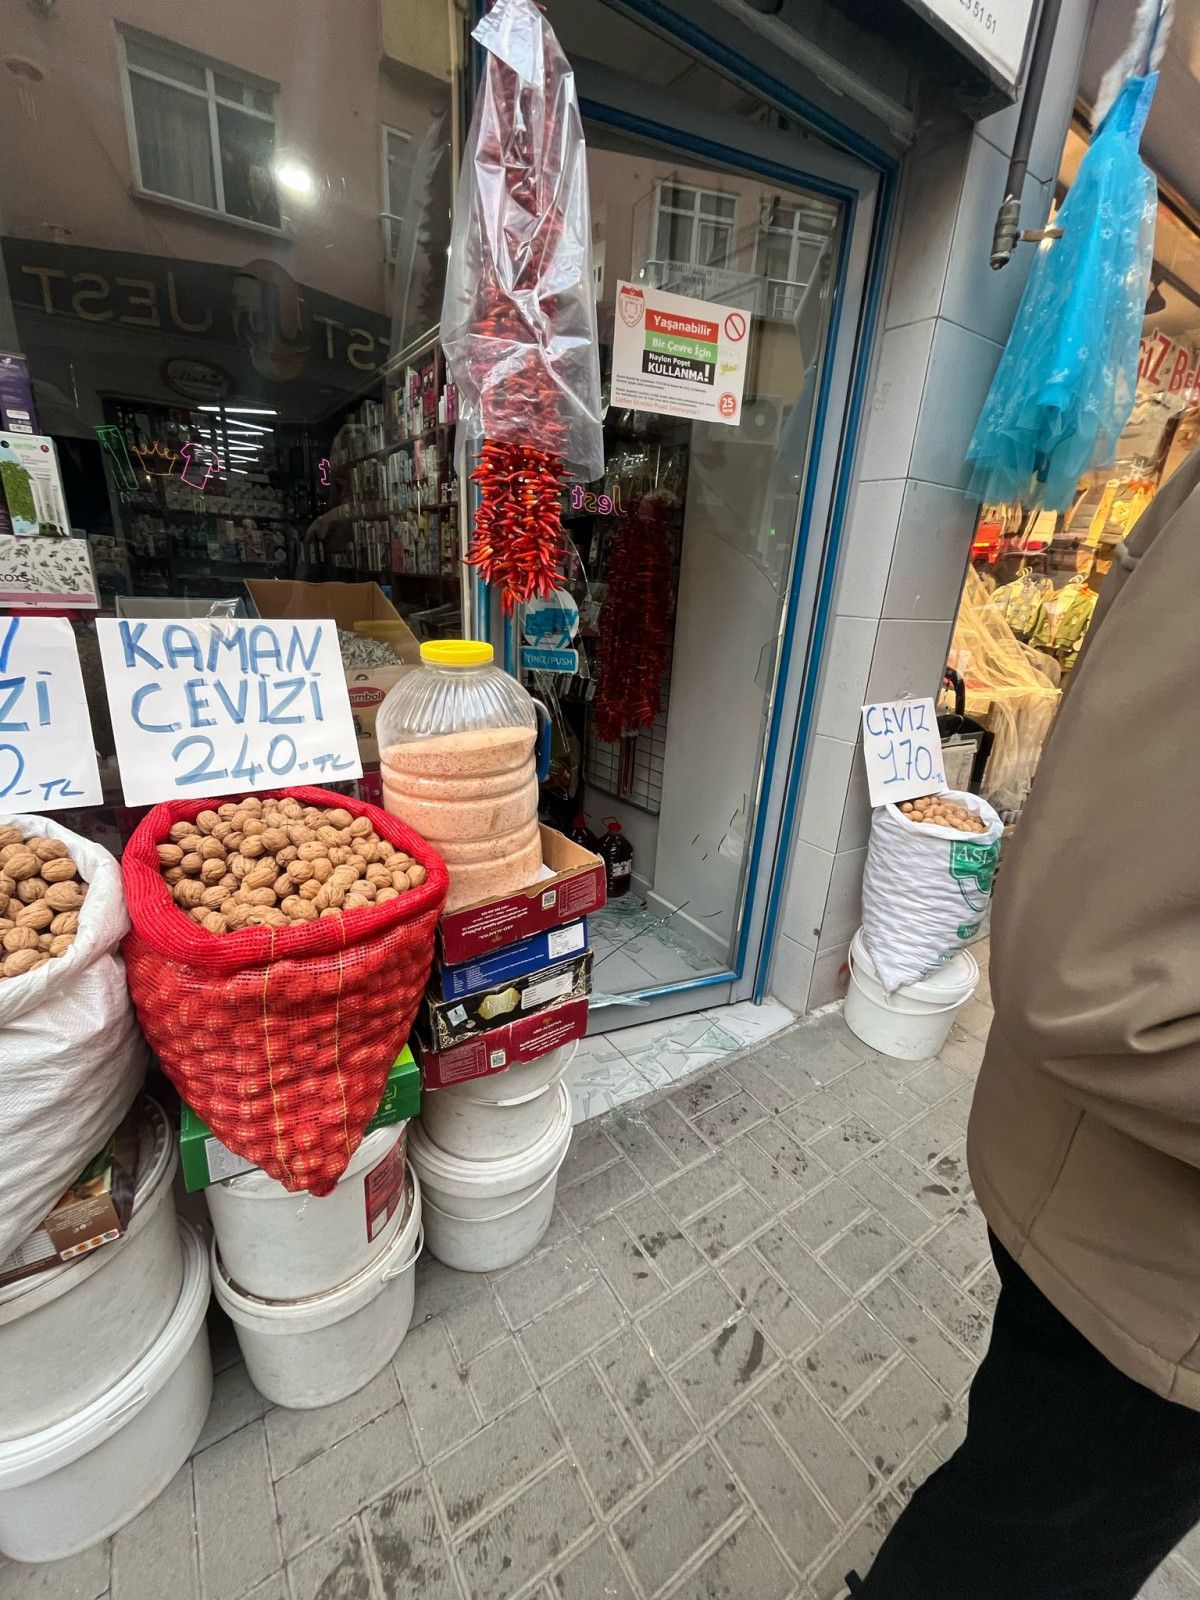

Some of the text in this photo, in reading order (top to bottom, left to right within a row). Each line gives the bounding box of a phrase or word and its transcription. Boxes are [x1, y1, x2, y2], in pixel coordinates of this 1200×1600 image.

[985, 13, 997, 34] 51
[653, 315, 711, 336] Yaşanabilir
[652, 337, 712, 359] Bir Çevre İçin
[649, 353, 691, 367] Naylon Poşet
[721, 398, 733, 408] 25
[118, 620, 323, 675] KAMAN
[131, 671, 324, 733] CEVİZİ
